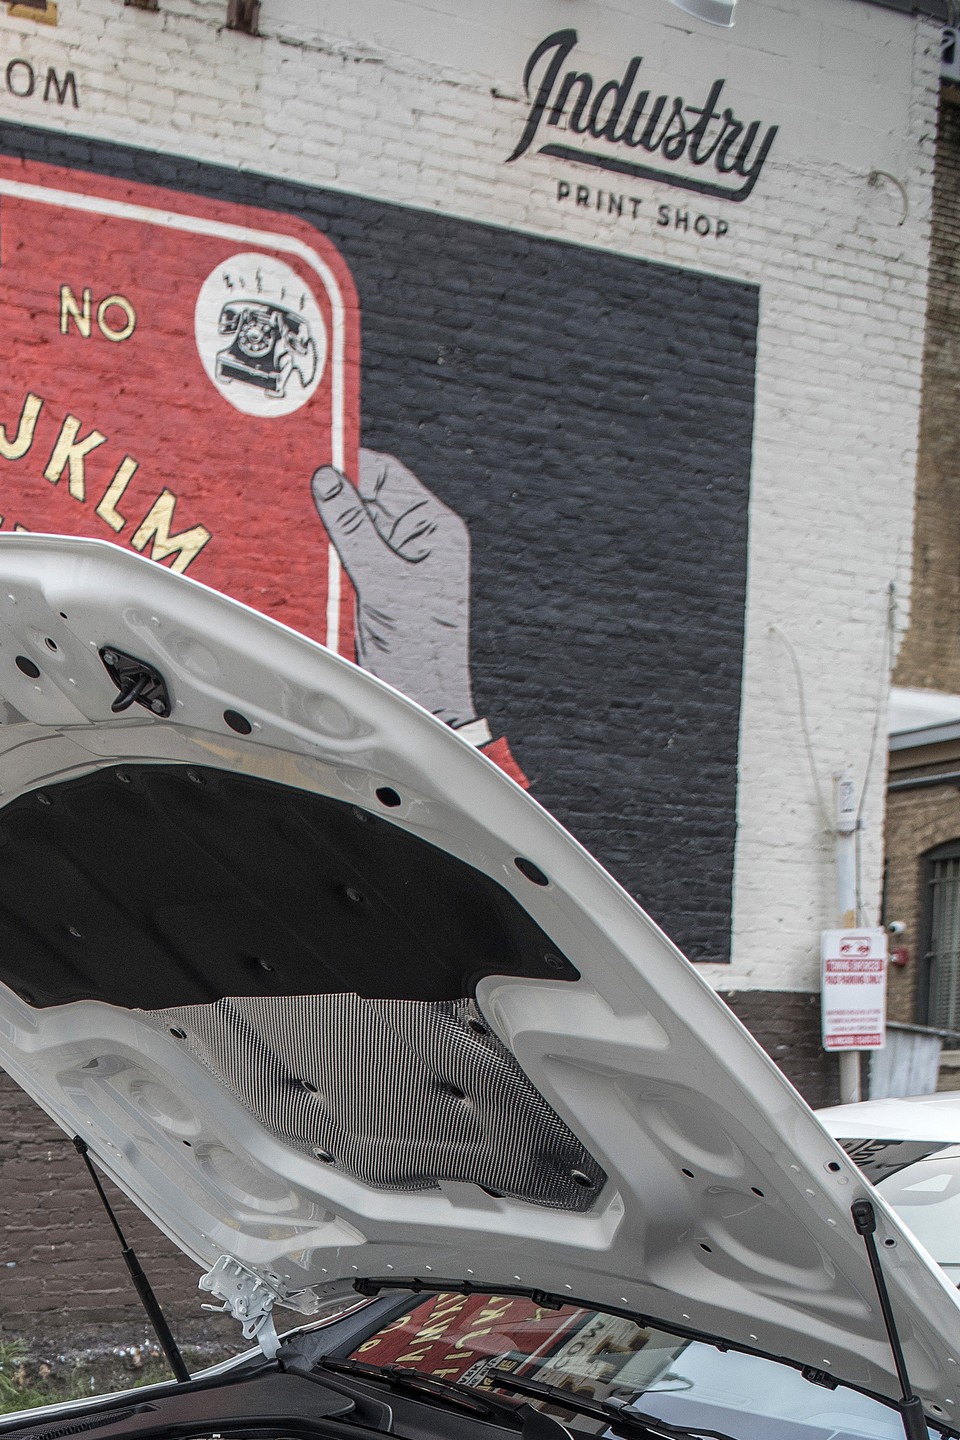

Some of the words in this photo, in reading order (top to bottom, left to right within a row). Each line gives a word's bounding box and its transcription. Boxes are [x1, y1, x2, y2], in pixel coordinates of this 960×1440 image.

[504, 28, 779, 202] Industry
[556, 179, 643, 219] PRINT
[656, 203, 730, 240] SHOP
[59, 284, 137, 342] NO
